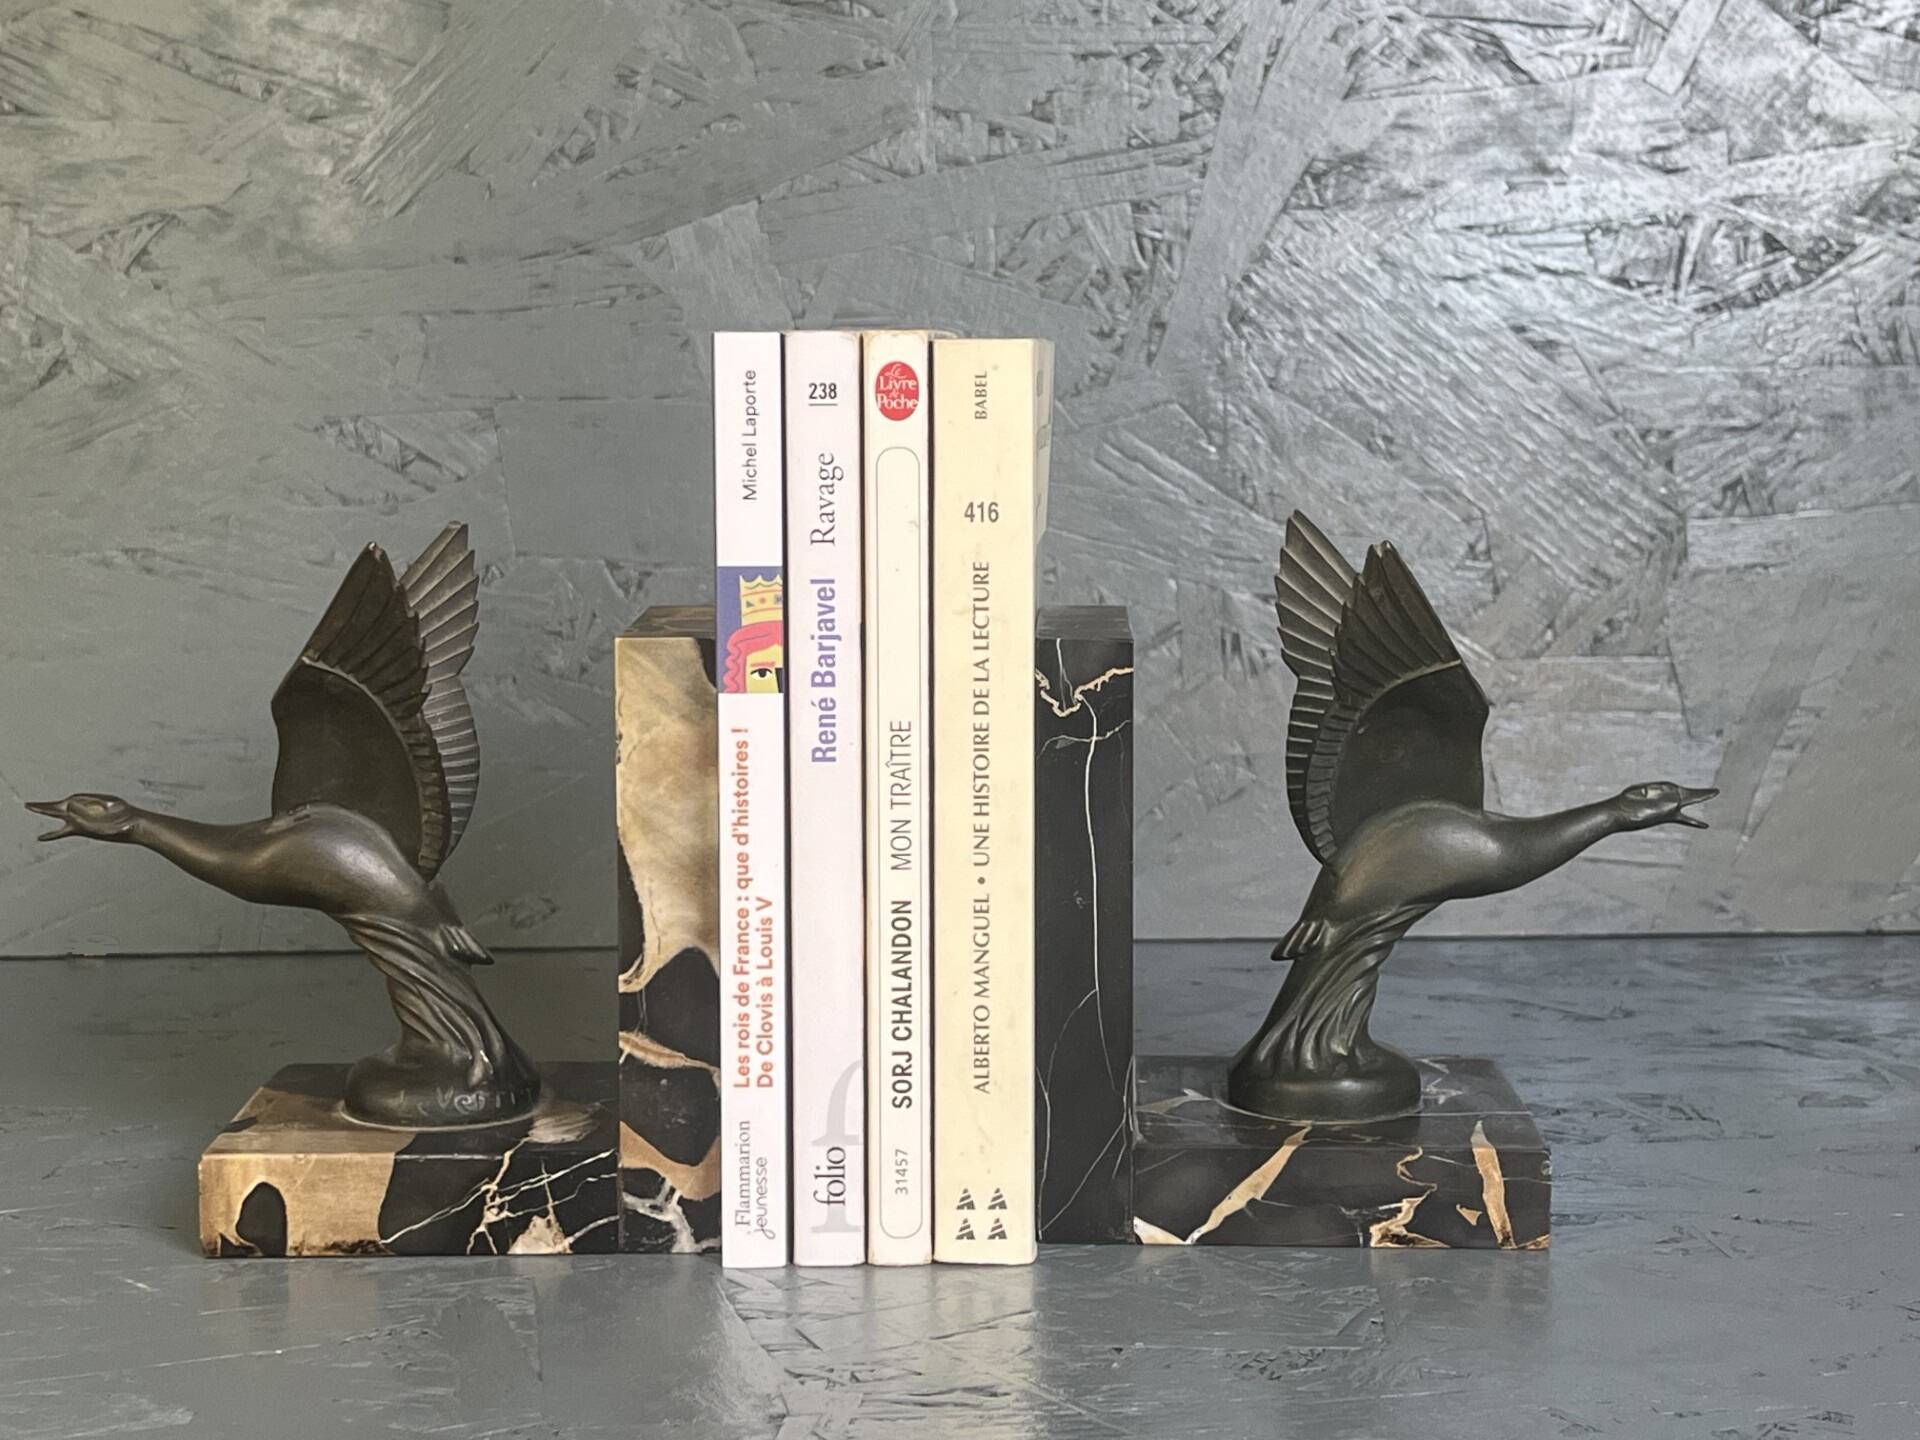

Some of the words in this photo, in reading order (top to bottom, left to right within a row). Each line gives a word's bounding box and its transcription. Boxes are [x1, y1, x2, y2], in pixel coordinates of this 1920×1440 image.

[742, 370, 759, 436] Laporte
[809, 383, 837, 399] 238
[876, 393, 919, 410] Poche
[880, 375, 918, 391] Livre
[975, 372, 987, 419] BABEL
[742, 443, 757, 500] Michel
[810, 453, 844, 545] Ravage
[964, 502, 999, 523] 416
[973, 562, 989, 650] LECTURE
[810, 579, 842, 687] Barjavel
[973, 658, 989, 682] LA
[973, 689, 989, 715] DE
[811, 698, 836, 762] René
[885, 721, 911, 810] TRAÎTRE
[973, 723, 990, 816] HISTOIRE
[890, 820, 912, 870] MON
[973, 824, 990, 866] UNE
[737, 852, 753, 890] que
[755, 897, 772, 911] V
[733, 910, 750, 975] France
[755, 917, 773, 969] Louis
[973, 894, 990, 998] MANGUEL
[732, 982, 750, 1007] de
[756, 977, 773, 987] à
[891, 901, 912, 1041] CHALANDON
[733, 1014, 750, 1048] rois
[756, 993, 773, 1055] Clovis
[973, 1005, 990, 1094] ALBERTO
[733, 1054, 750, 1088] Les
[757, 1062, 773, 1088] De
[892, 1051, 912, 1108] SORJ
[735, 1121, 750, 1226] Flammarion
[813, 1147, 846, 1205] folio
[895, 1149, 908, 1194] 31457
